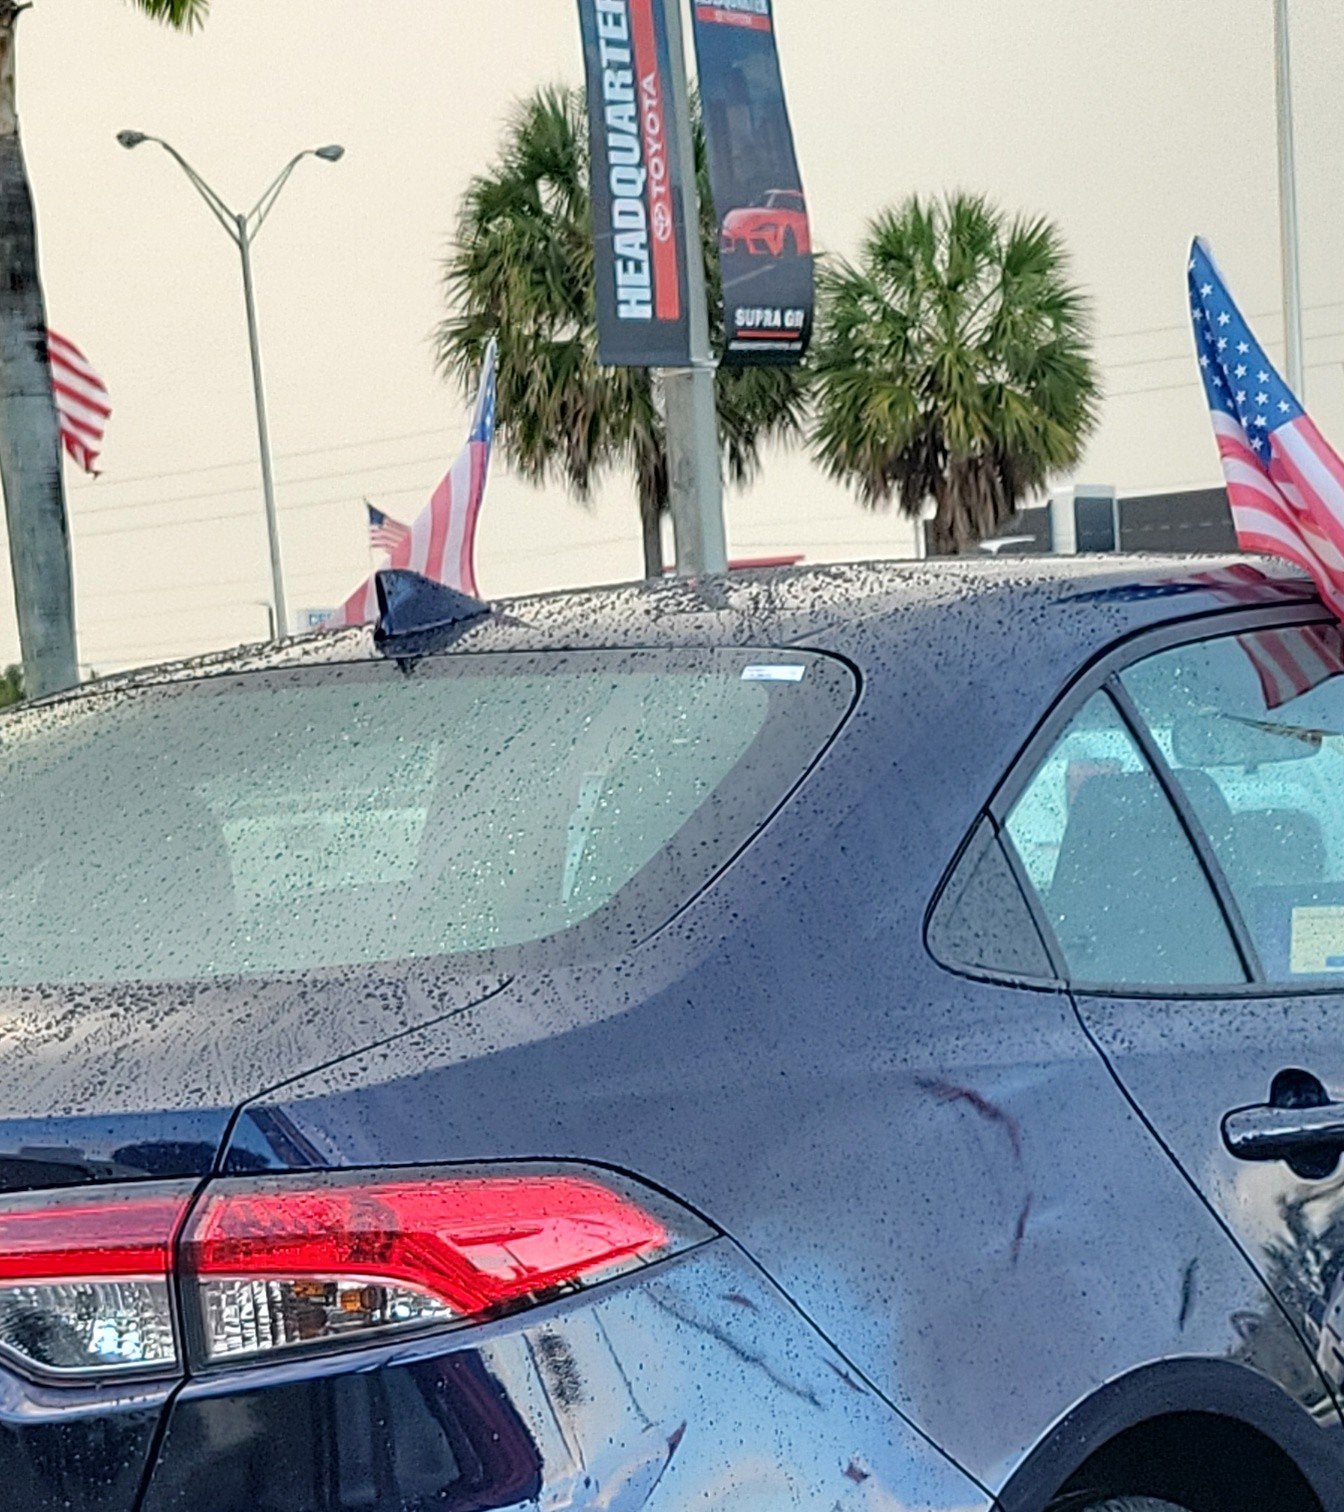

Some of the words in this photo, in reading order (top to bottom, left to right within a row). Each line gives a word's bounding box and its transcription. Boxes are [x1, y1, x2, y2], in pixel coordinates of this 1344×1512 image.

[640, 72, 669, 198] TOYOTA
[735, 307, 781, 328] SUPRA
[783, 309, 805, 329] GR
